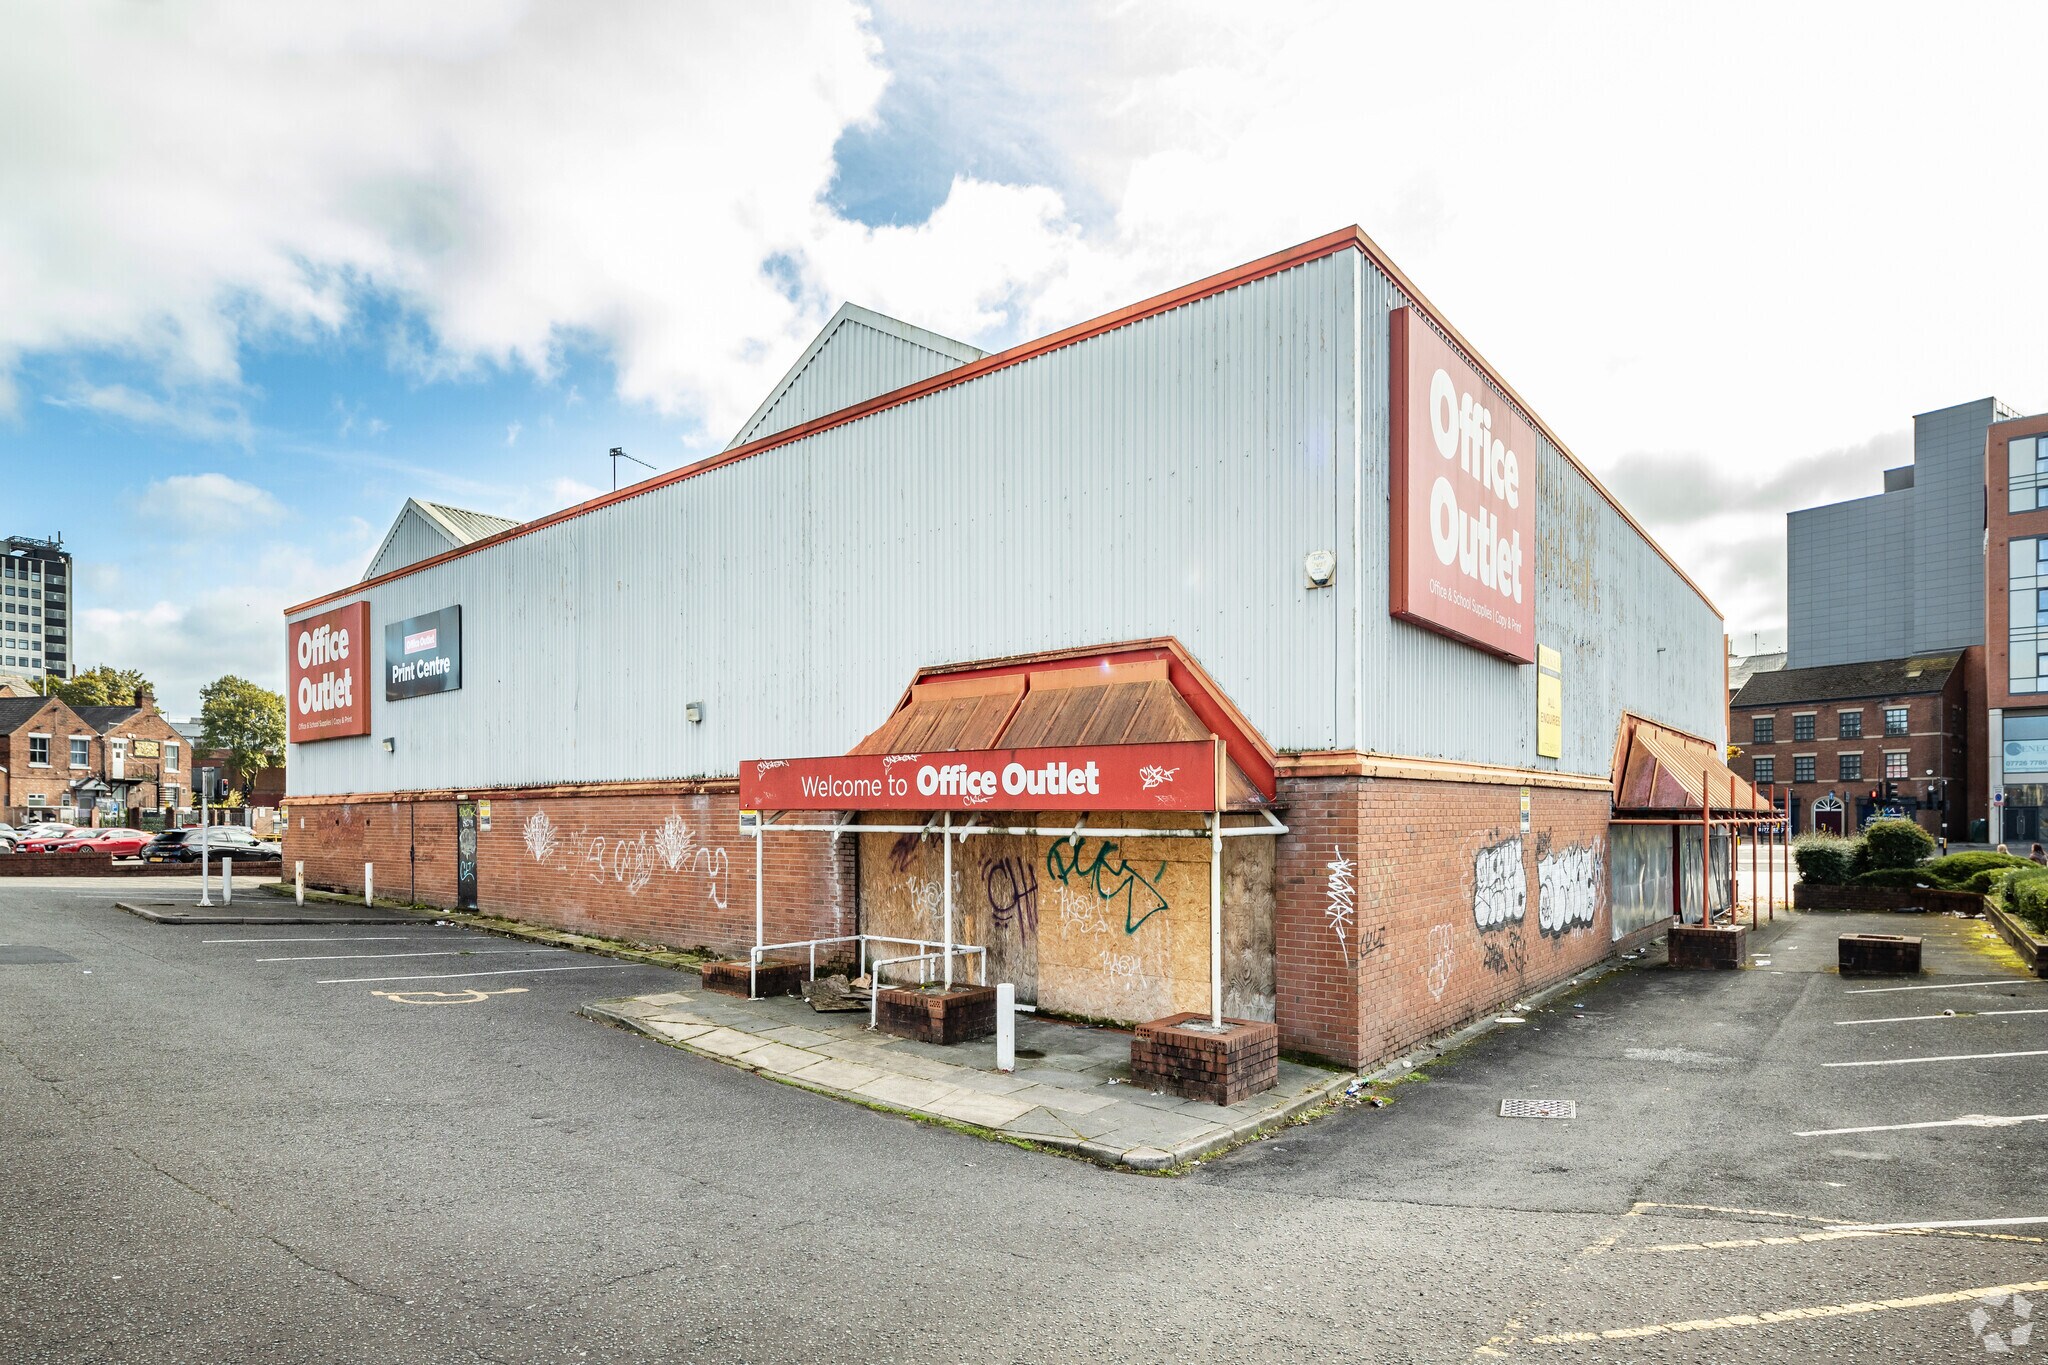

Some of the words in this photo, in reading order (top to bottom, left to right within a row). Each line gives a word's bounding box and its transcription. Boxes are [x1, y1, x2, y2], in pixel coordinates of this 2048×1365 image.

[1429, 368, 1520, 510] Office
[1430, 476, 1522, 604] Outlet
[1430, 579, 1447, 599] Office
[1448, 588, 1452, 601] &
[1453, 590, 1472, 609] School
[1472, 598, 1493, 620] Supplies
[1495, 610, 1507, 630] Copy
[1512, 618, 1522, 634] Print
[297, 623, 350, 670] Office
[406, 639, 420, 650] Office
[420, 634, 435, 647] Outlet
[298, 667, 352, 715] Outlet
[392, 661, 415, 683] Print
[416, 656, 451, 679] Centre
[801, 775, 882, 798] Welcome
[888, 774, 908, 797] to
[916, 763, 997, 797] Office
[1001, 761, 1100, 796] Outlet
